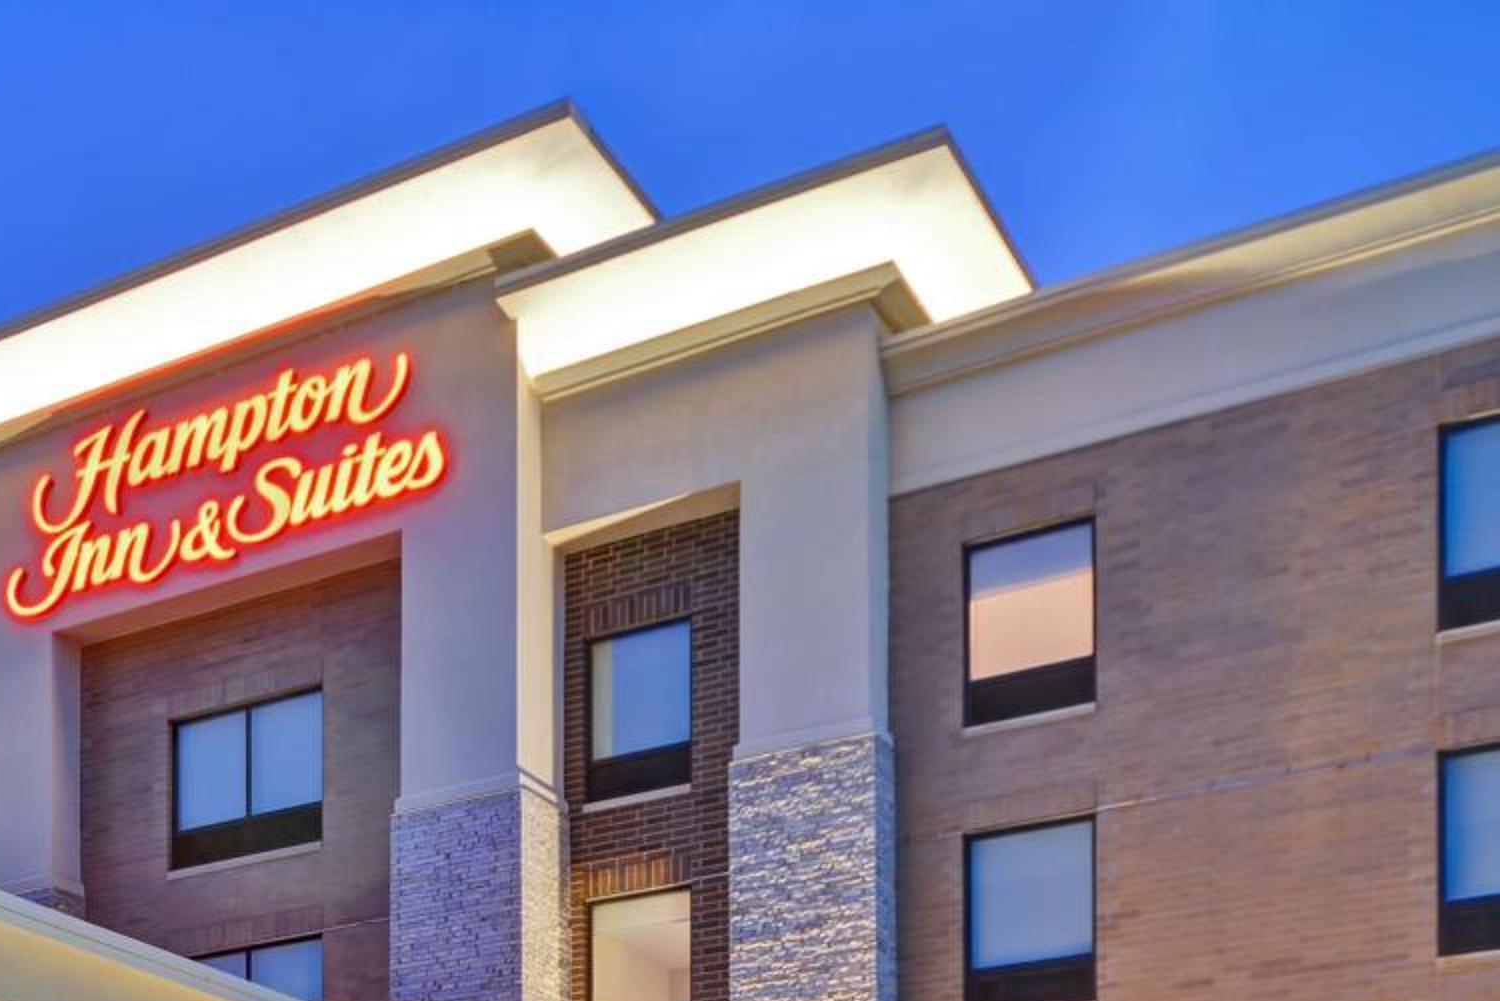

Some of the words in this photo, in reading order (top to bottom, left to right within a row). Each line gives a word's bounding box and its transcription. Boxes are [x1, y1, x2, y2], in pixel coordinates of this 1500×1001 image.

[6, 518, 181, 617] Inn
[180, 499, 236, 561] &
[226, 431, 444, 543] Suites
[32, 352, 409, 534] Hampton
